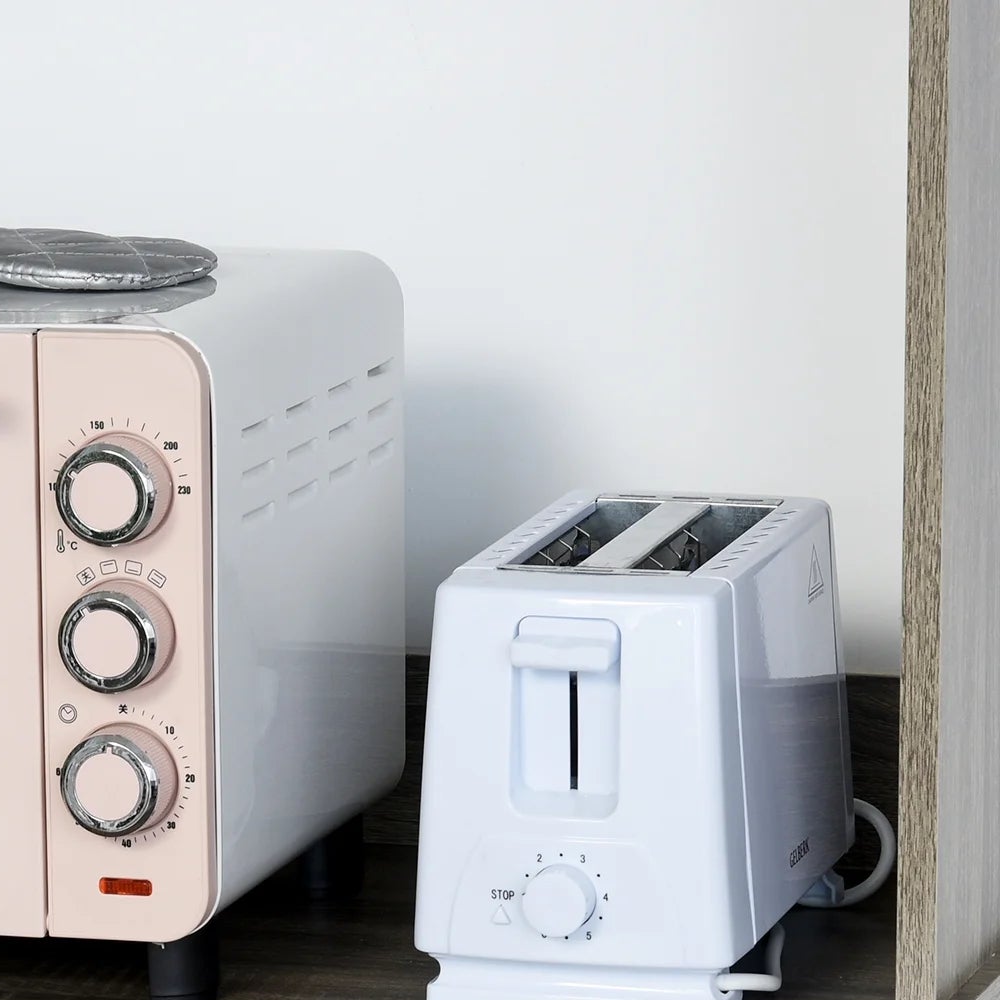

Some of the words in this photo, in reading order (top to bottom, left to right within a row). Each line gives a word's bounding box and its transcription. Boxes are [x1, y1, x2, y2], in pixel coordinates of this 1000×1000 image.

[89, 420, 105, 430] 150
[163, 440, 179, 451] 200
[177, 485, 192, 495] 230
[118, 703, 129, 715] 关
[164, 725, 175, 735] 10
[185, 773, 196, 784] 20
[166, 821, 176, 830] 30
[121, 838, 132, 848] 40
[536, 853, 543, 863] 2
[579, 854, 586, 864] 3
[490, 888, 516, 901] STOP
[602, 892, 609, 902] 4
[585, 930, 593, 941] 5
